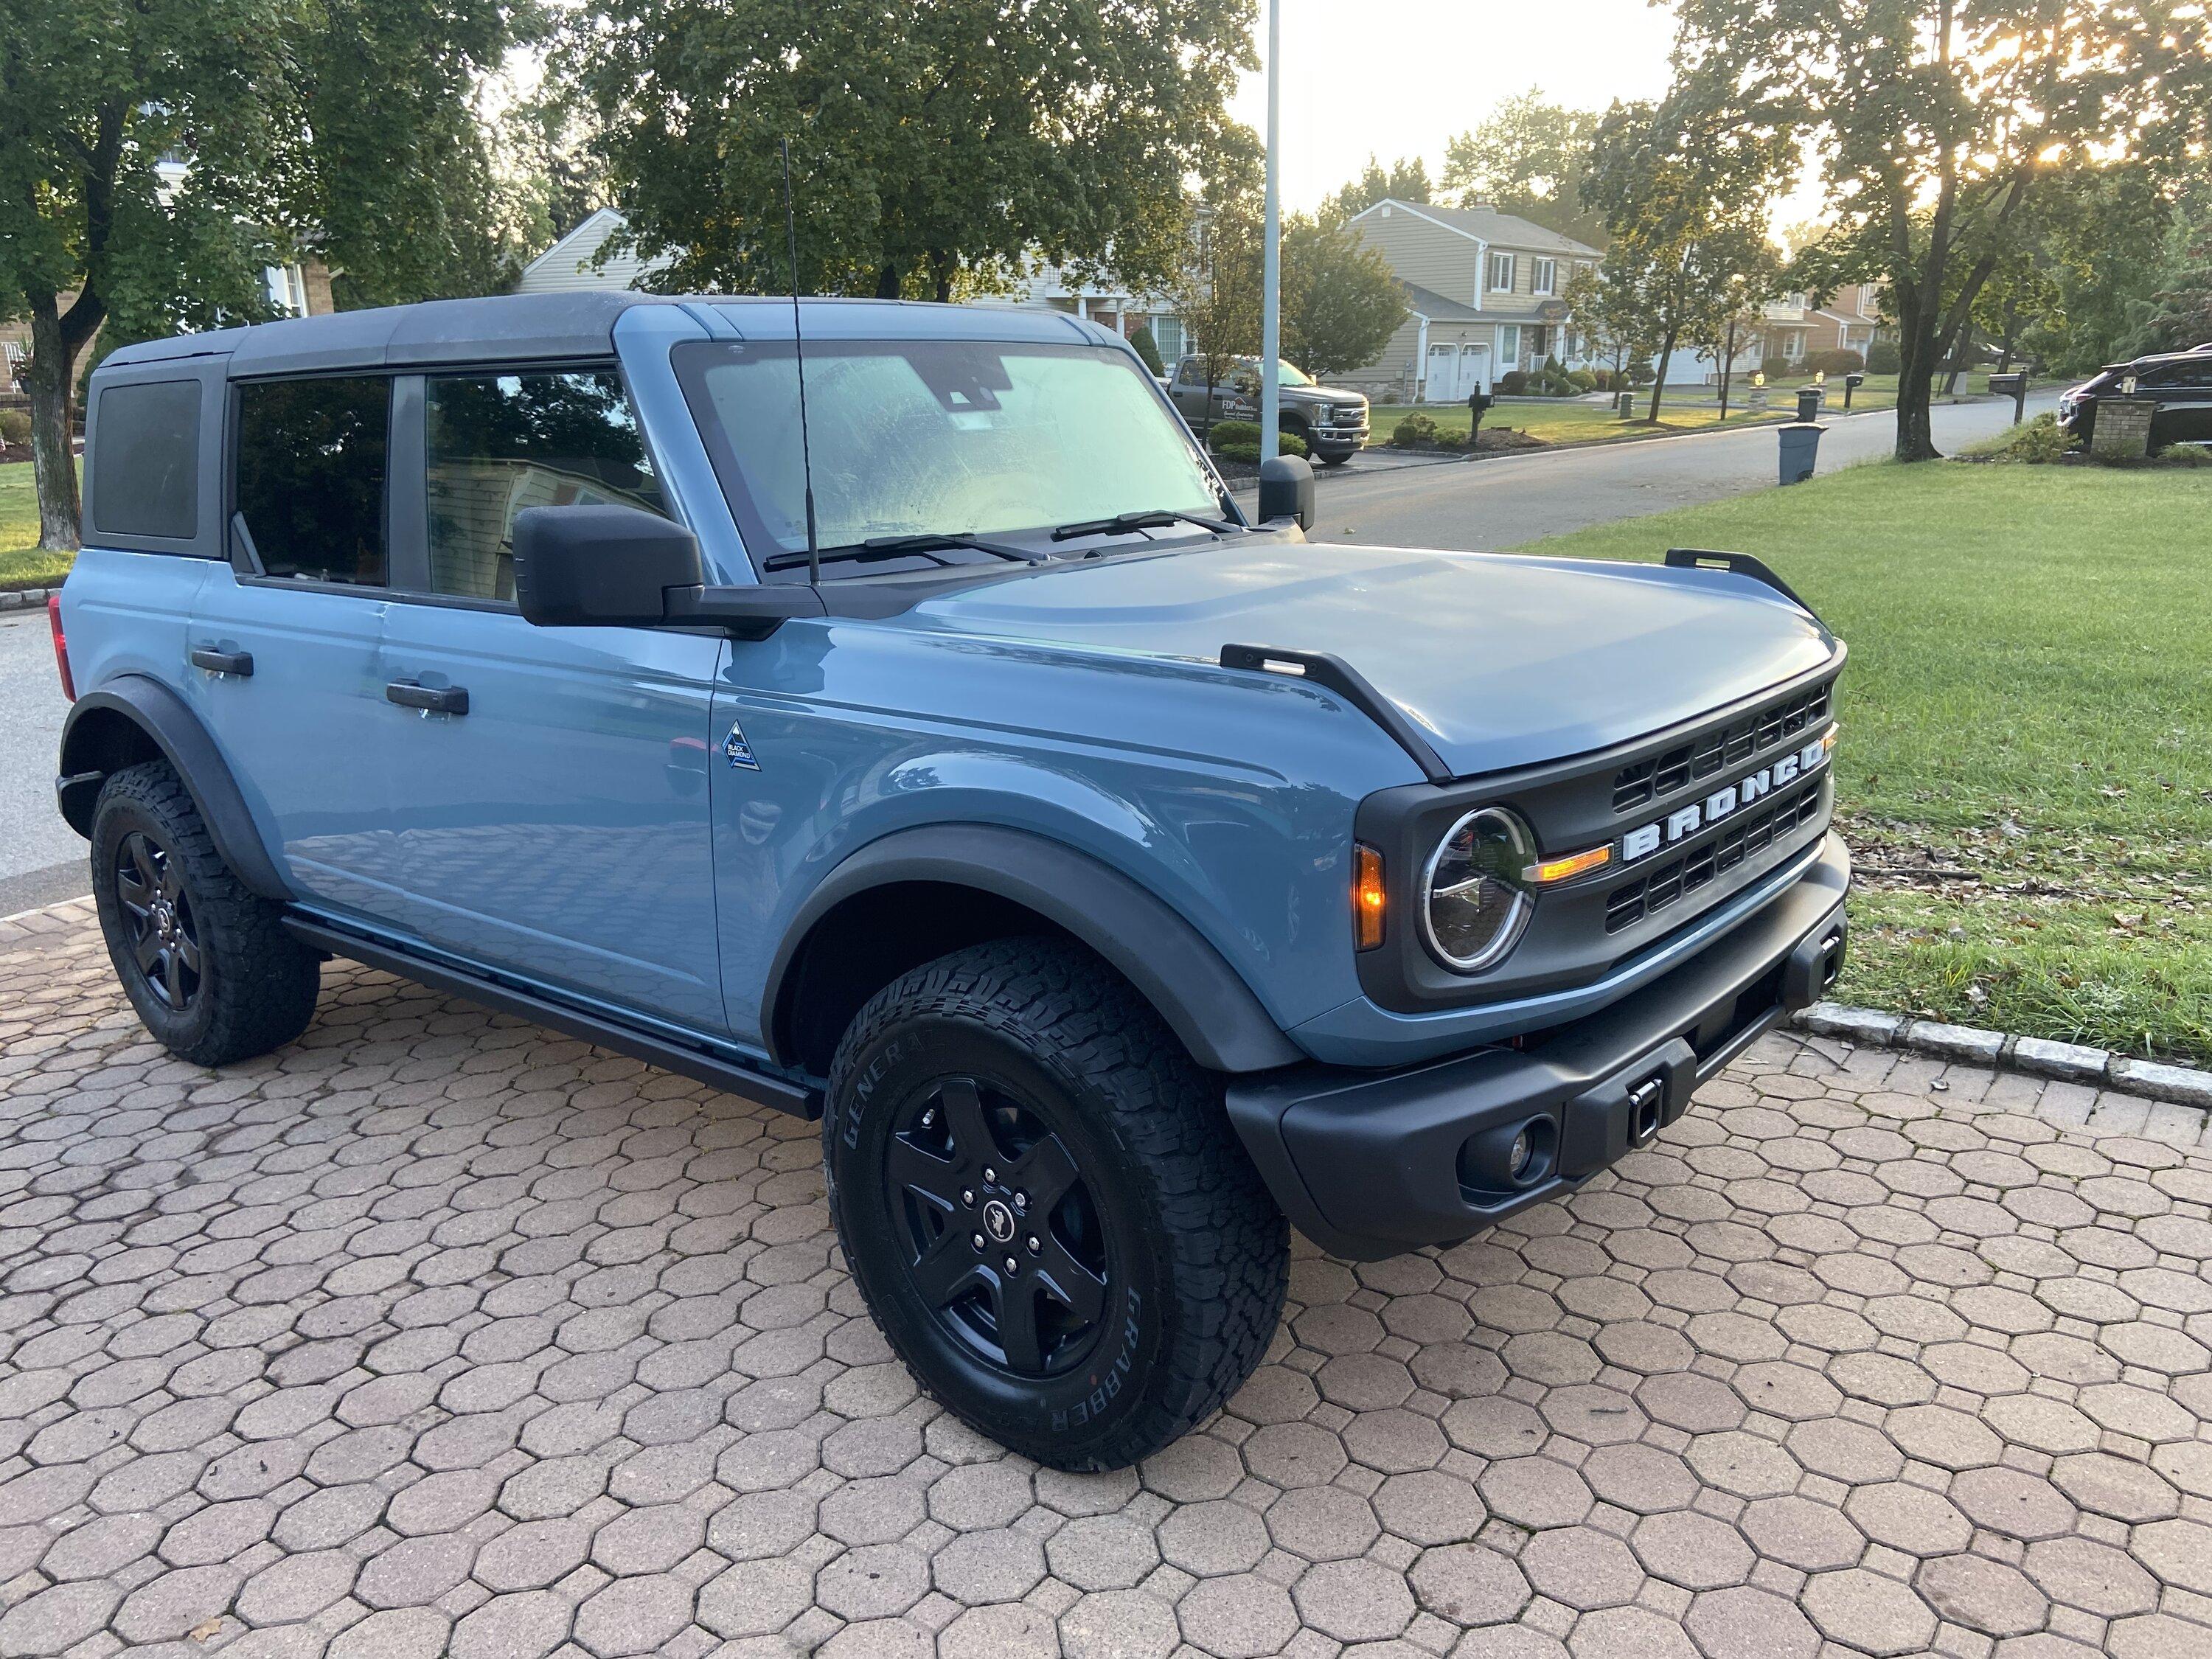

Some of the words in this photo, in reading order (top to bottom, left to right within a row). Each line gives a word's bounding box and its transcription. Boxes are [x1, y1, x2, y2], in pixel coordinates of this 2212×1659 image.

[1222, 400, 1236, 410] FDP
[727, 743, 743, 752] BLACK
[727, 750, 751, 759] DIAMOND
[1623, 739, 1823, 861] BRONCO
[1051, 1286, 1142, 1432] GRABBER
